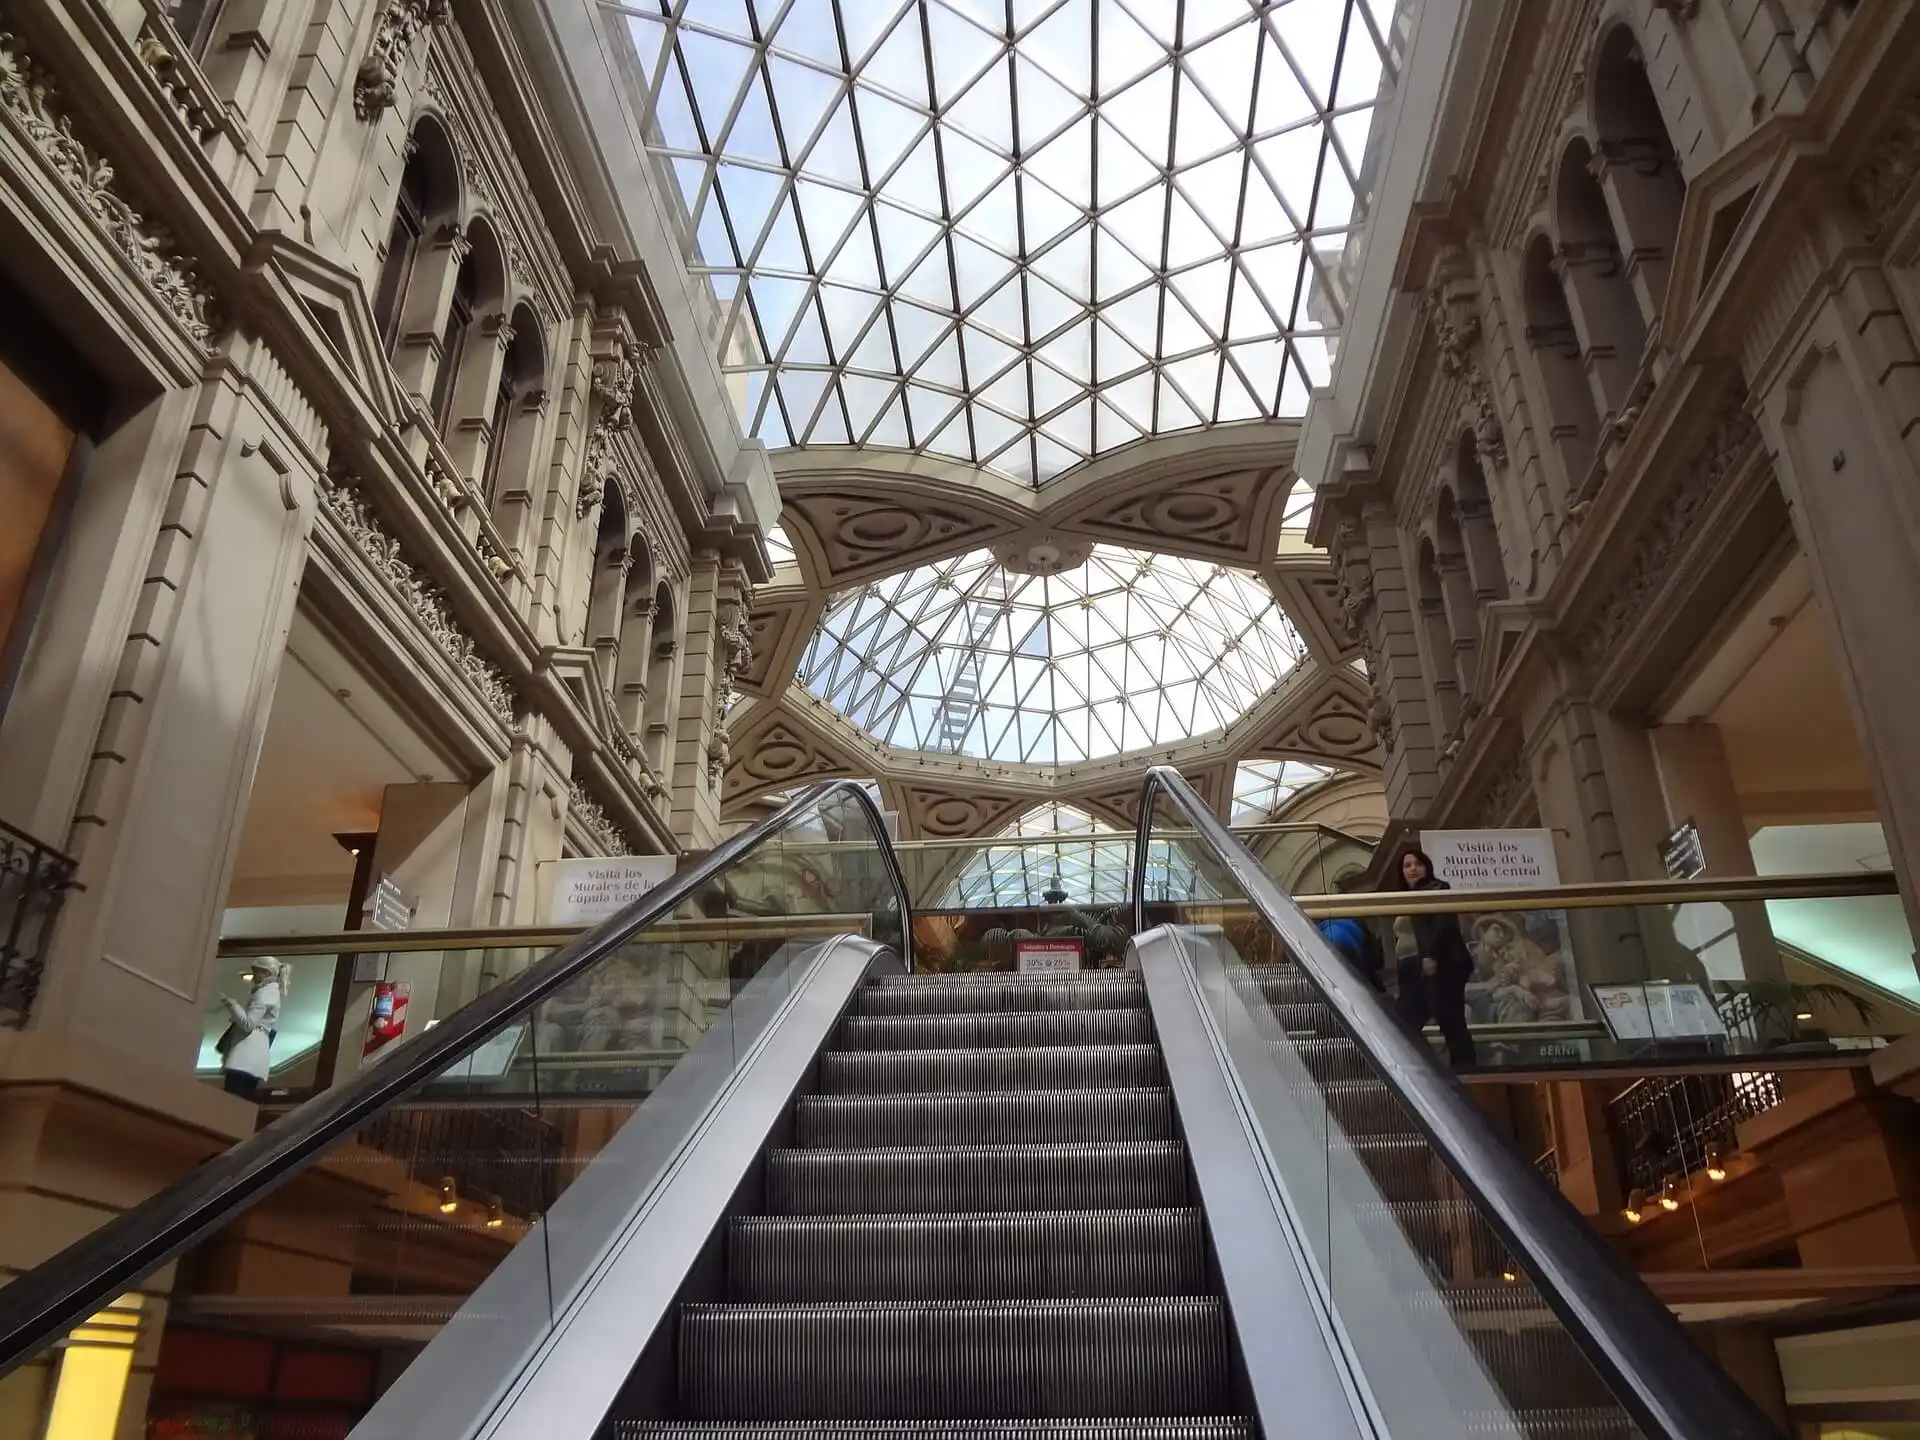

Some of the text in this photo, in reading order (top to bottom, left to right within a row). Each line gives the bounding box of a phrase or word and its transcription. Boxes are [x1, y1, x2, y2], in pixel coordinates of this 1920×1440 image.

[1500, 842, 1517, 853] los
[1445, 853, 1535, 865] Murales de la
[625, 868, 642, 879] los
[1442, 865, 1541, 879] Cúpula Central
[574, 880, 620, 892] Murales
[624, 880, 640, 890] de
